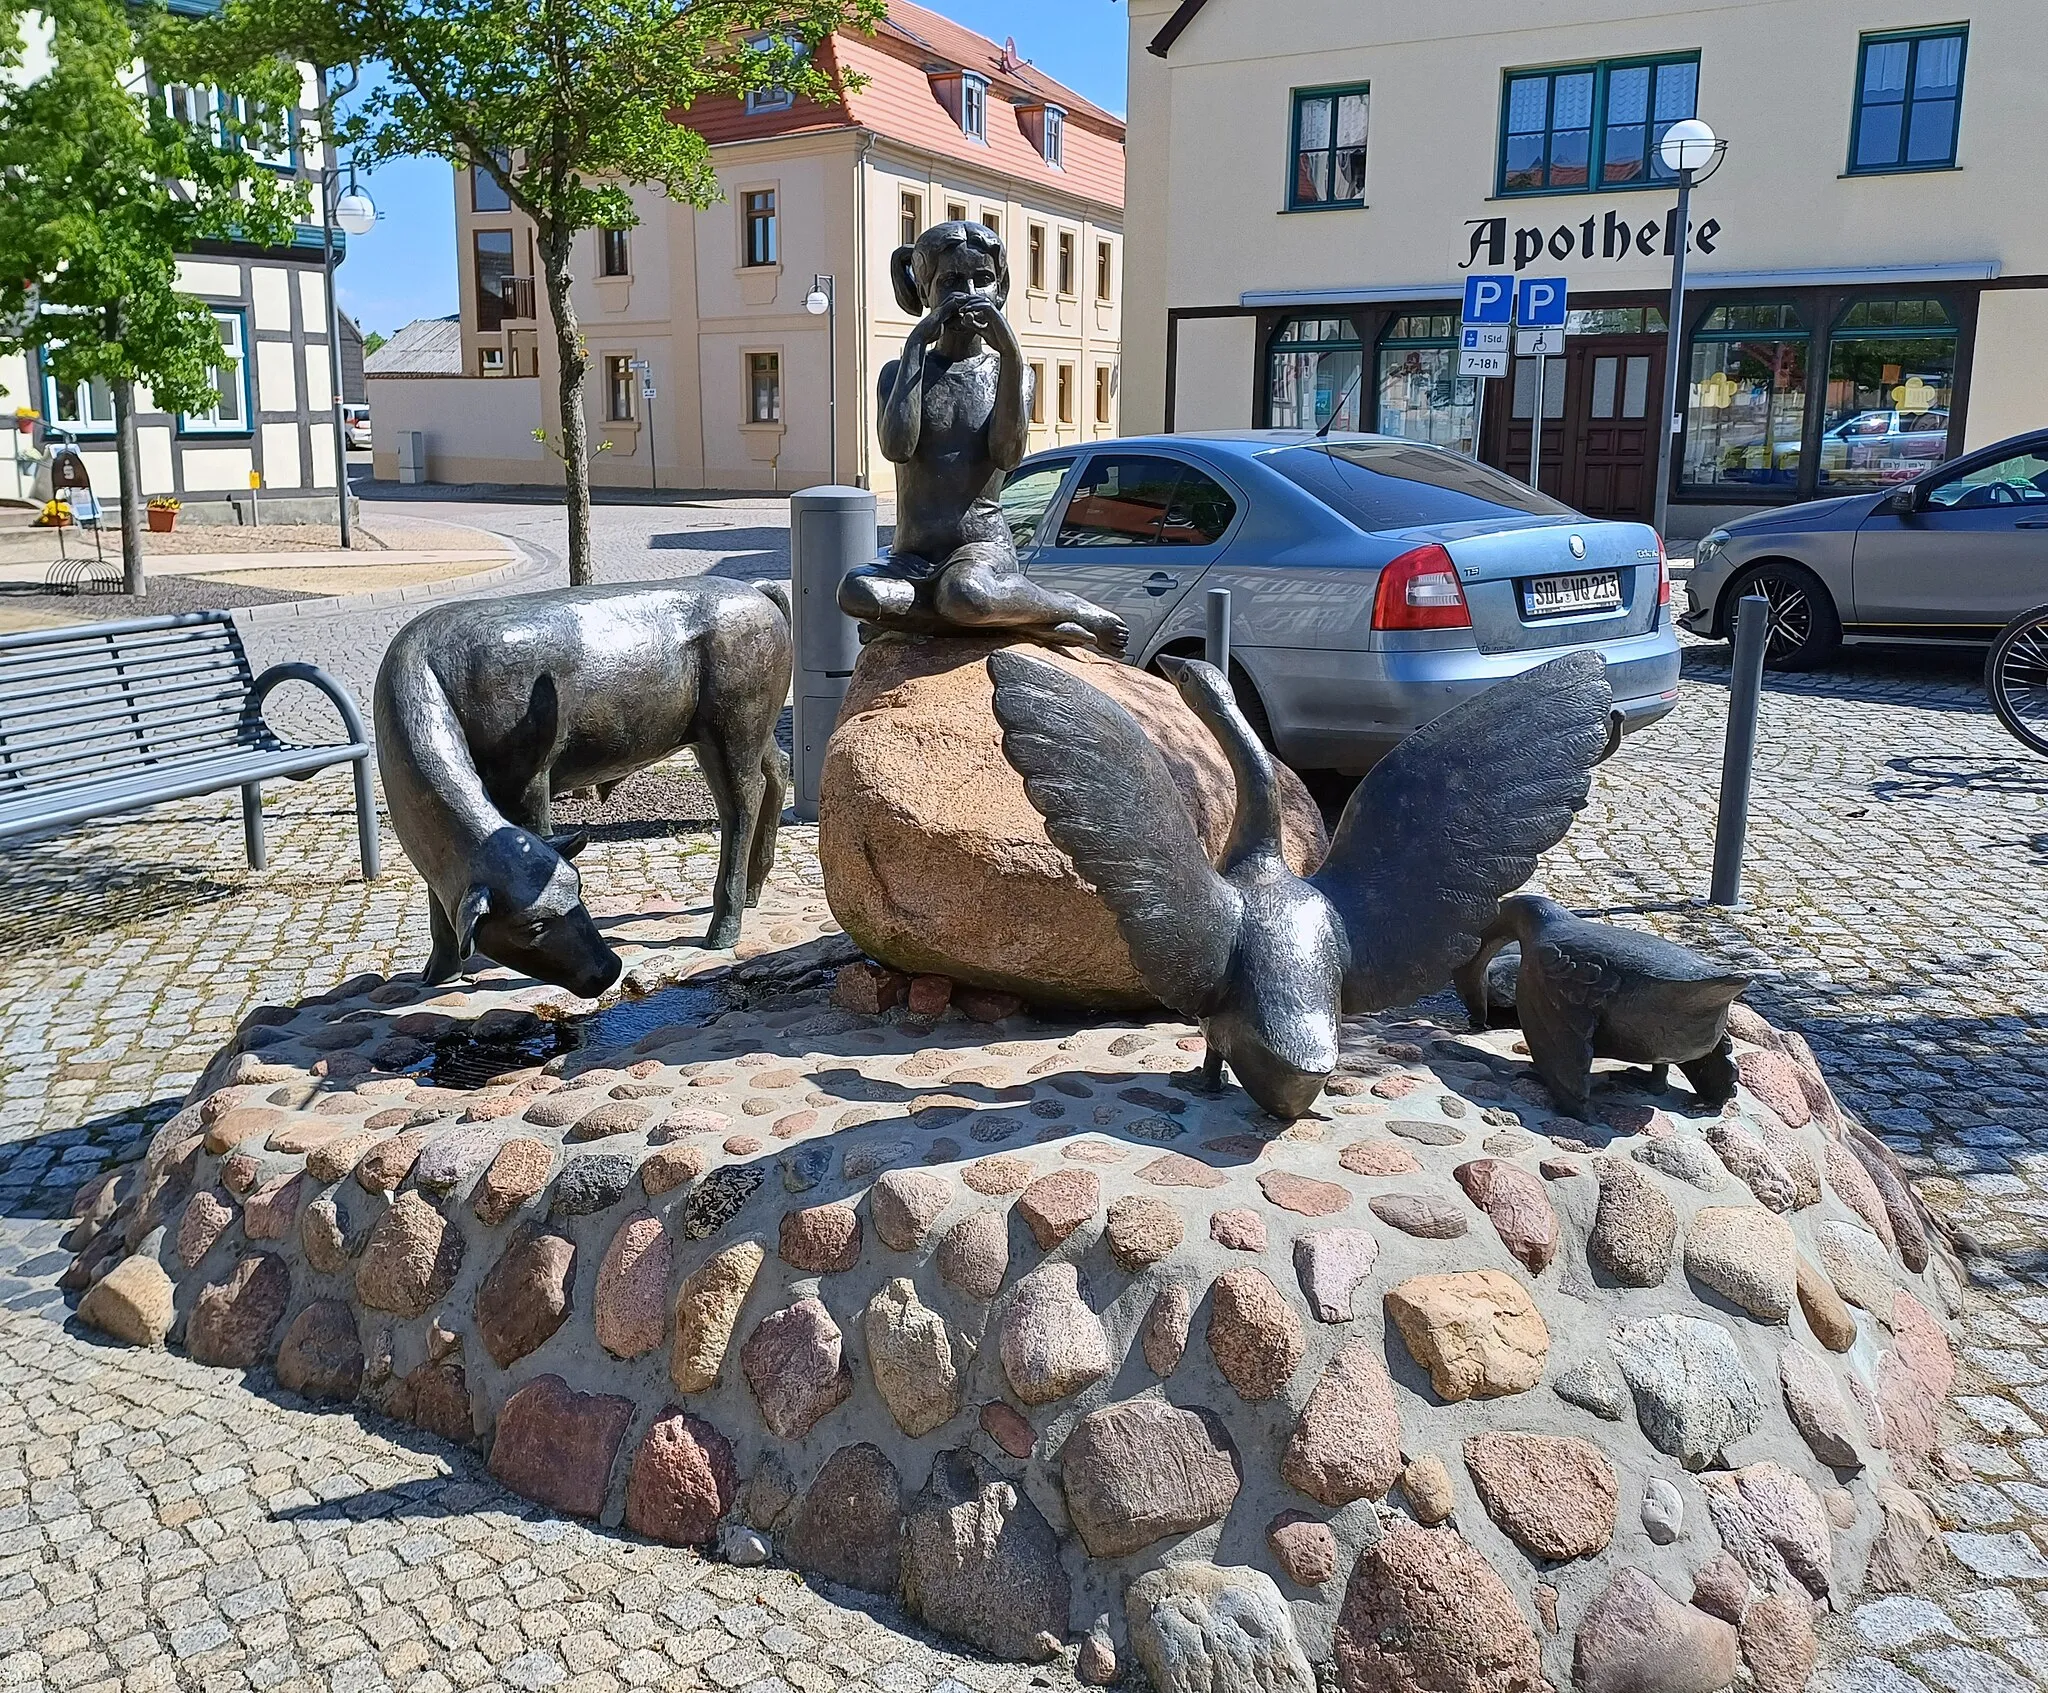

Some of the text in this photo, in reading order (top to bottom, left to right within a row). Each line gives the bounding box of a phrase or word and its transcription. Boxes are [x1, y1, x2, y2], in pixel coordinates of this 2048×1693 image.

[1458, 207, 1722, 271] Apotheke
[1473, 281, 1502, 318] P
[1528, 284, 1555, 320] P
[1534, 574, 1618, 606] SDL VQ 213
